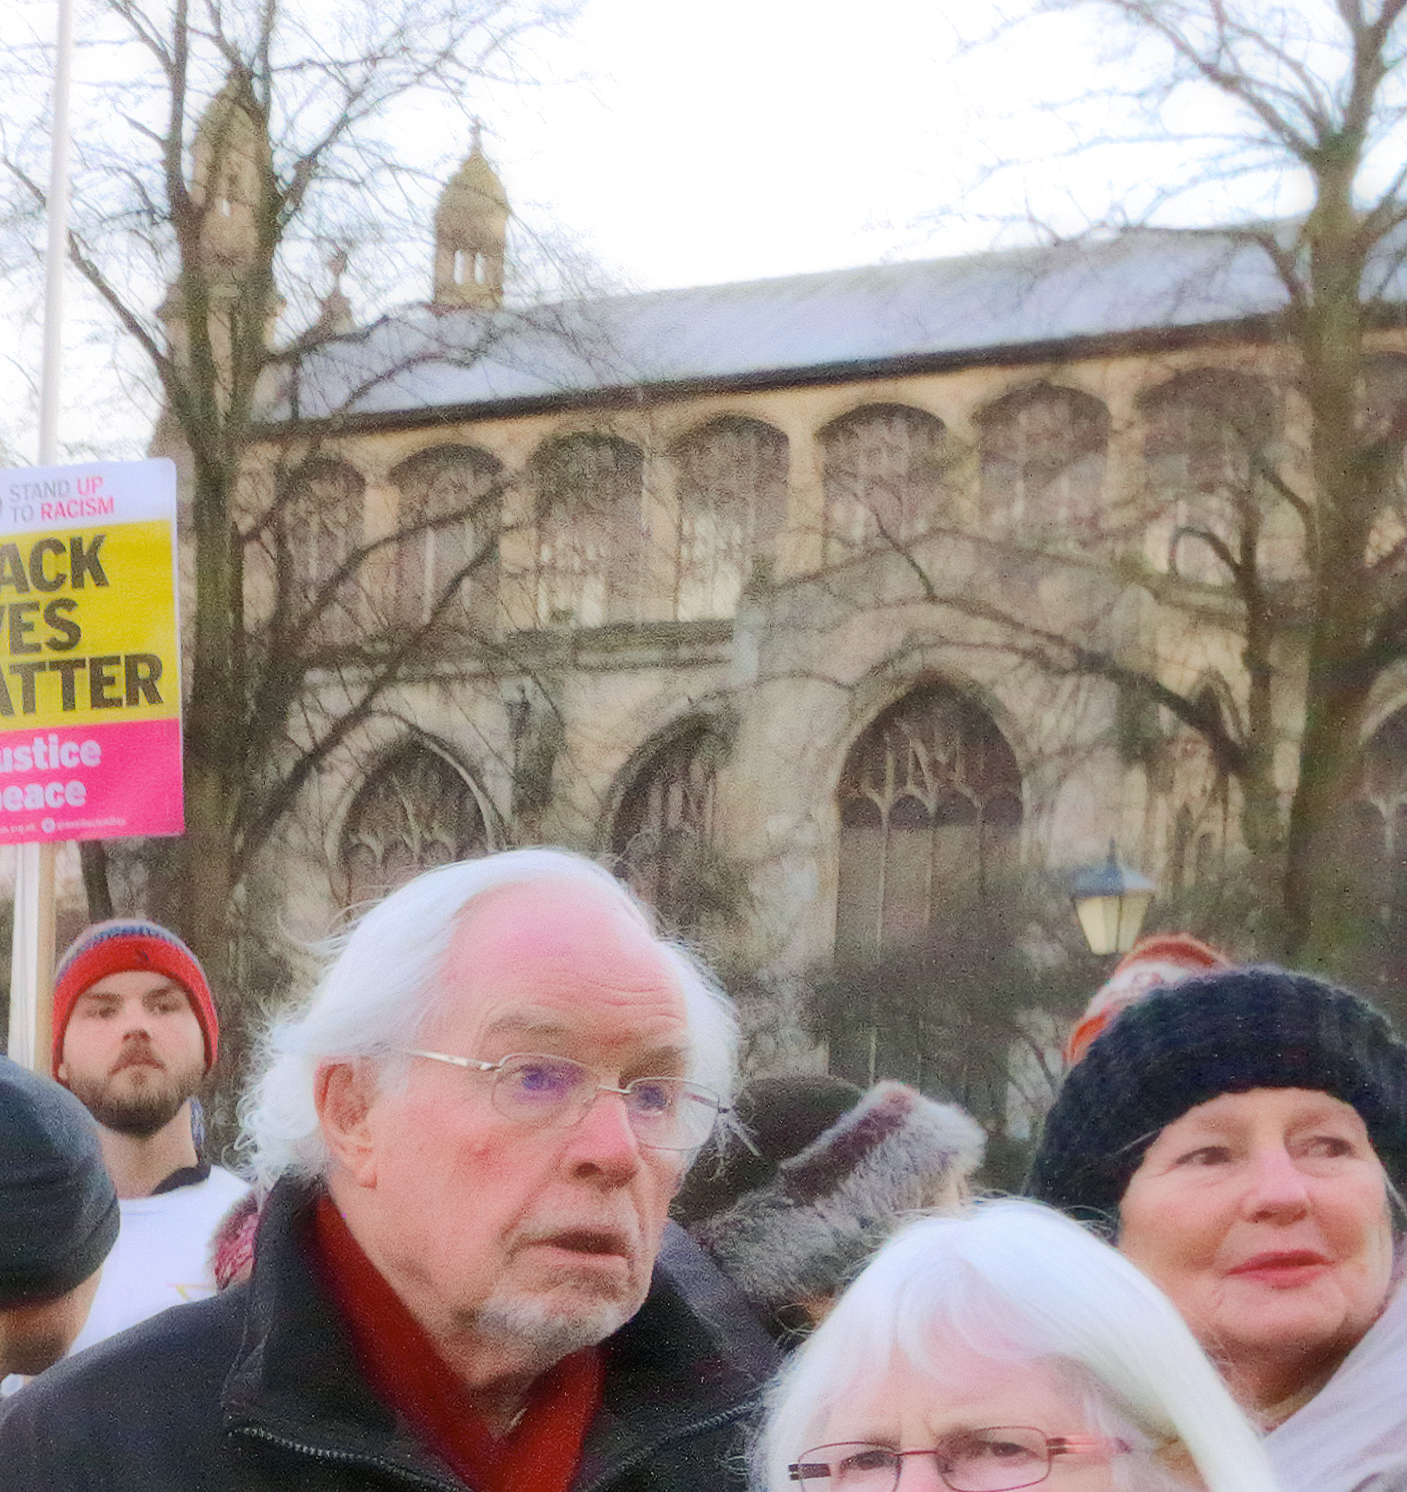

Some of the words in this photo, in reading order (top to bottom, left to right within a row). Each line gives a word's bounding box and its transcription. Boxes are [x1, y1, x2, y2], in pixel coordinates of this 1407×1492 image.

[9, 480, 70, 502] STAND
[76, 477, 103, 495] UP
[9, 503, 34, 521] TO
[41, 496, 115, 521] RACISM
